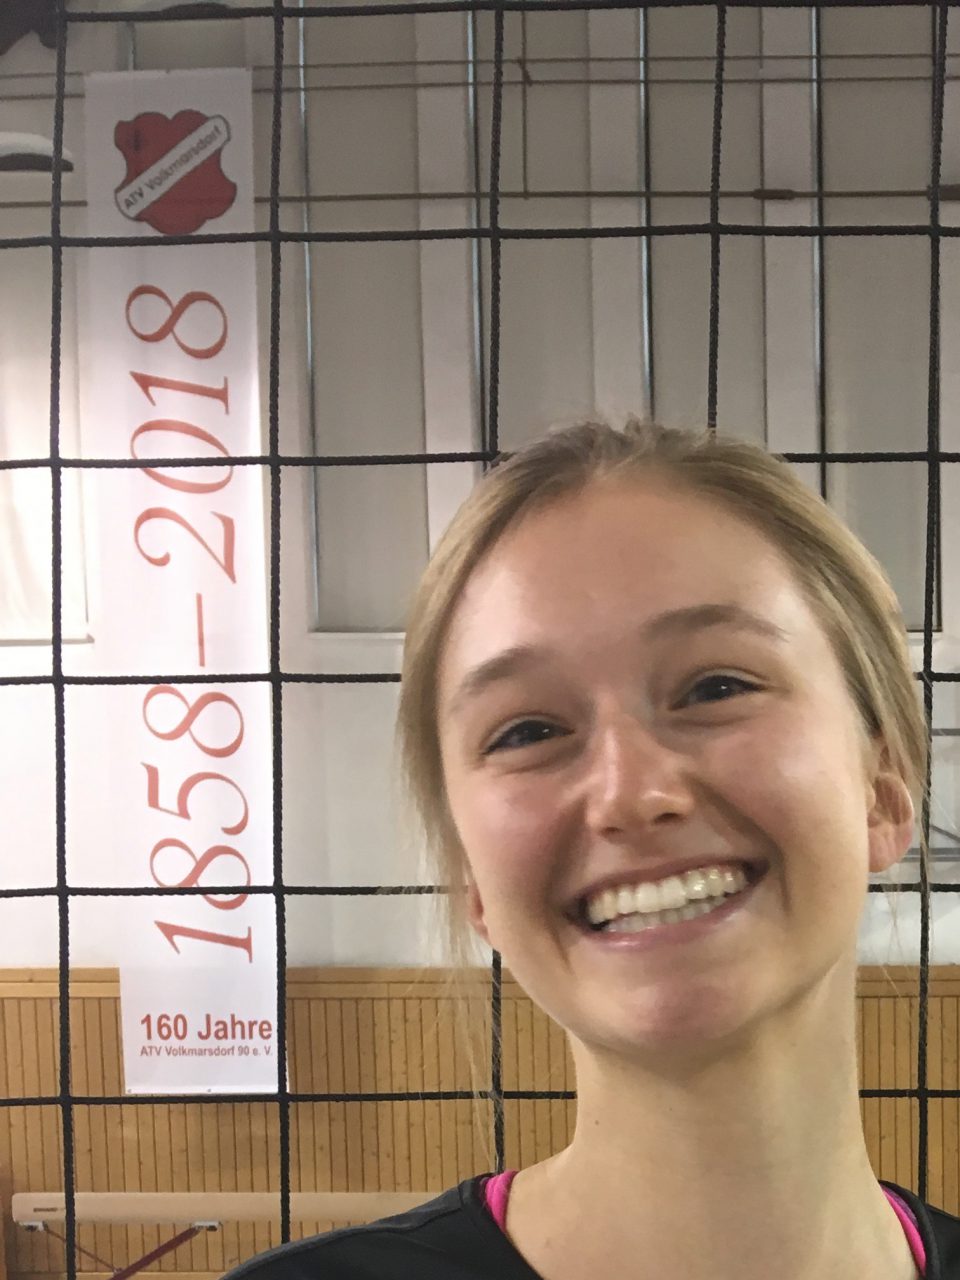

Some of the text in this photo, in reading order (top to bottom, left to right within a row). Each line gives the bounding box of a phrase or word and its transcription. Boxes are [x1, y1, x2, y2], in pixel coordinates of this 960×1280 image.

[124, 187, 144, 209] ATV
[140, 1013, 273, 1041] 160 Jahre
[140, 1046, 161, 1057] ATV
[165, 1046, 235, 1057] Volkmarsdorf
[238, 1046, 250, 1057] 90
